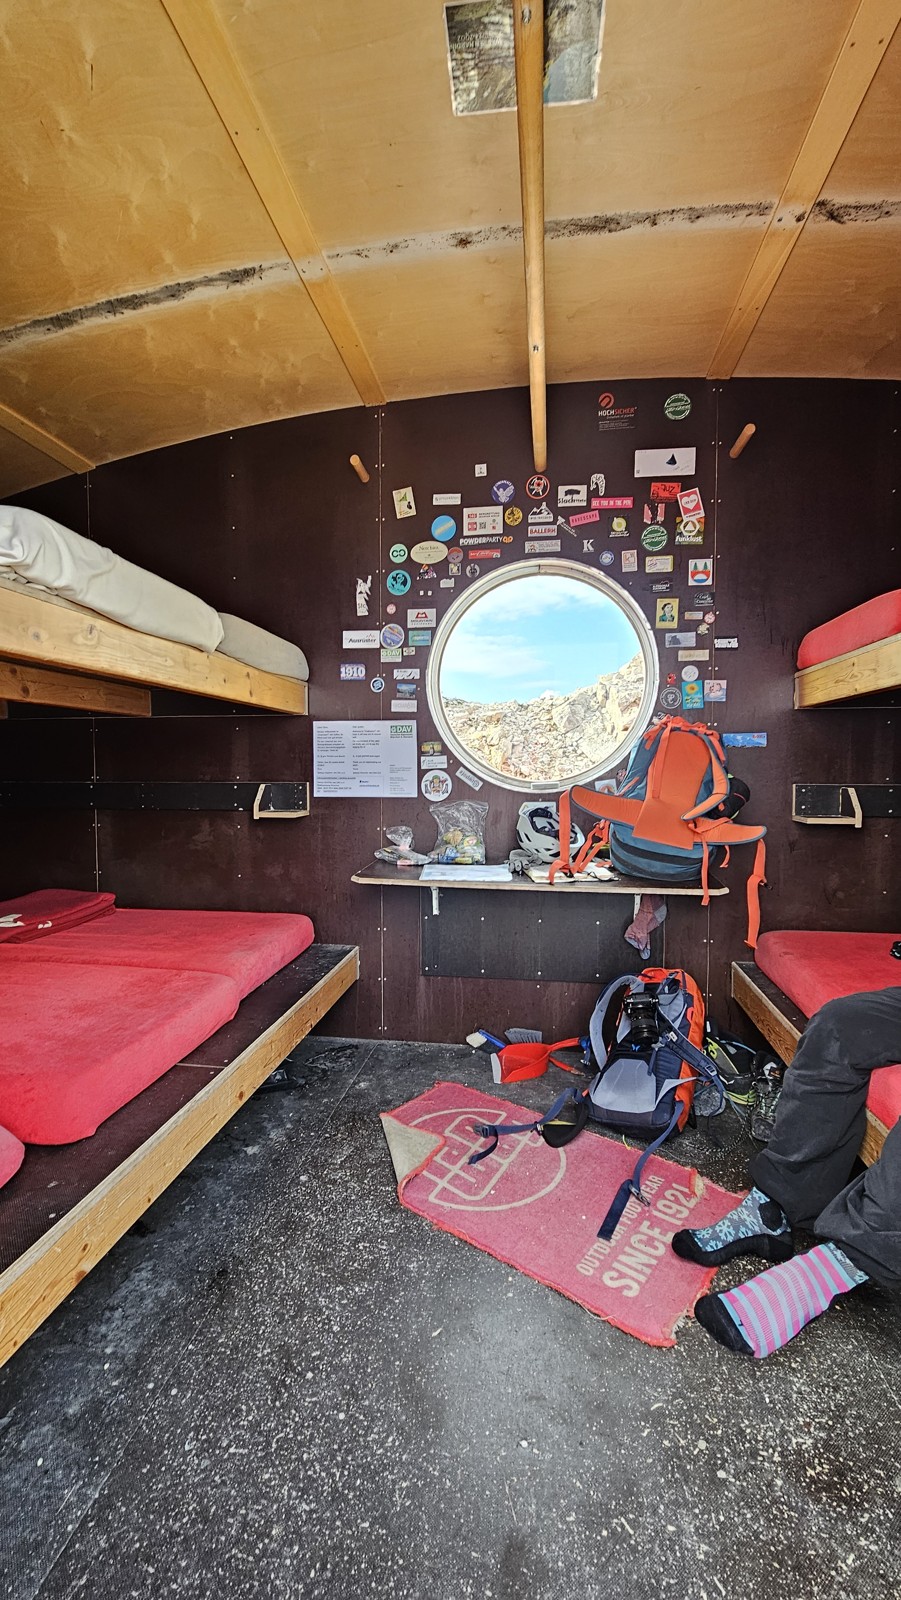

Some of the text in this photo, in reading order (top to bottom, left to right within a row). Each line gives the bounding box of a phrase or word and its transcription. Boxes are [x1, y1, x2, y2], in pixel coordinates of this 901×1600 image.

[459, 536, 503, 546] POWDERPARTY
[340, 666, 366, 677] 1910
[576, 1224, 628, 1275] OUTDOR
[603, 1183, 697, 1297] SINCE 1921
